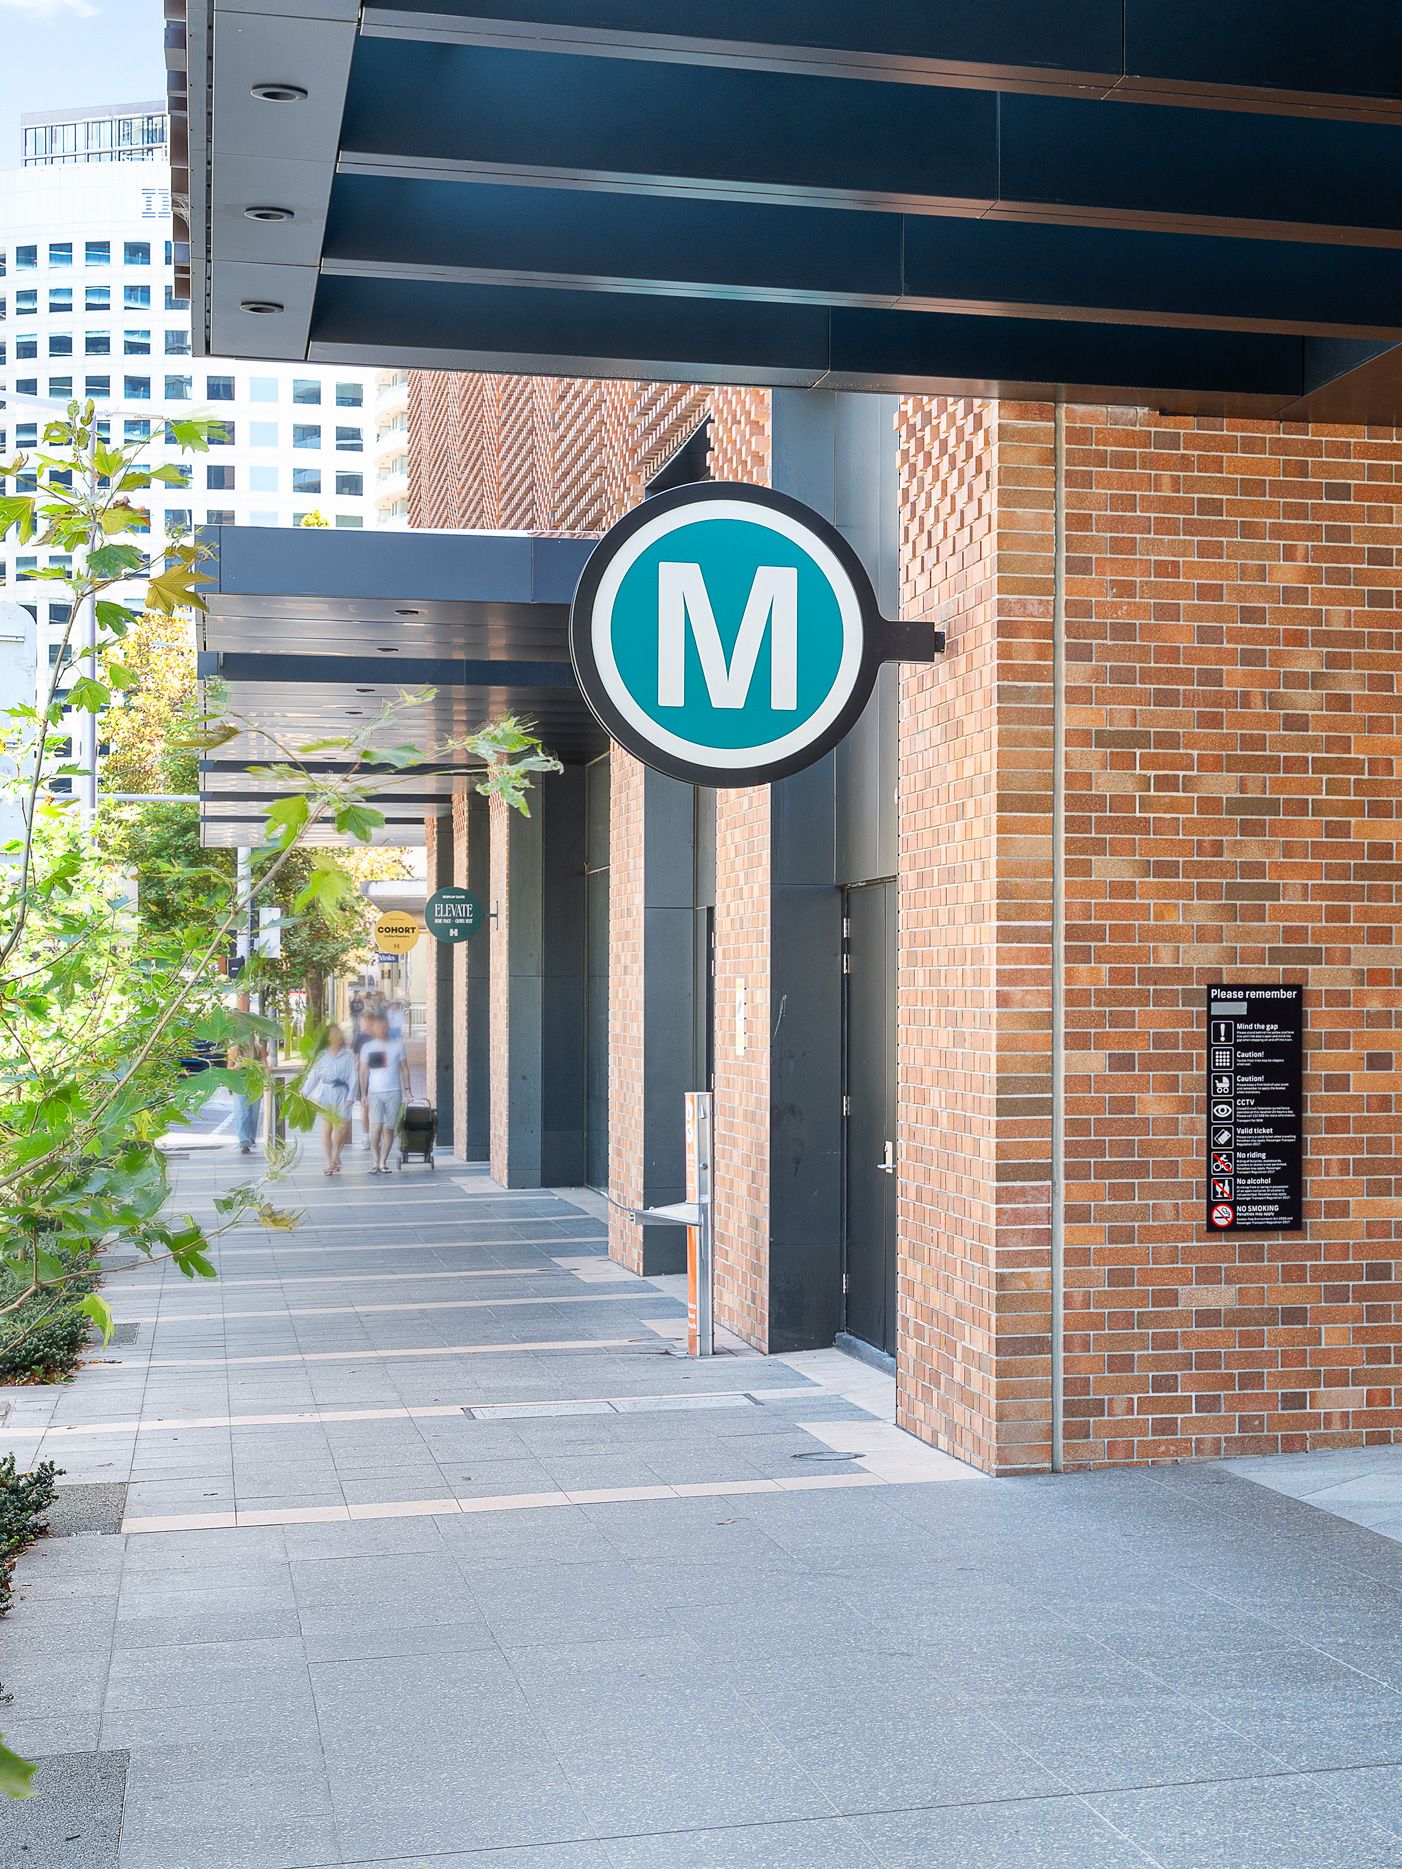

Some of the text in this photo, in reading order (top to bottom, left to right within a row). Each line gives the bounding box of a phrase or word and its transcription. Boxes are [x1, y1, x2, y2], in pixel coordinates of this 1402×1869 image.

[658, 561, 798, 710] M
[435, 904, 473, 917] ELEVATE
[1211, 989, 1297, 999] Please remember
